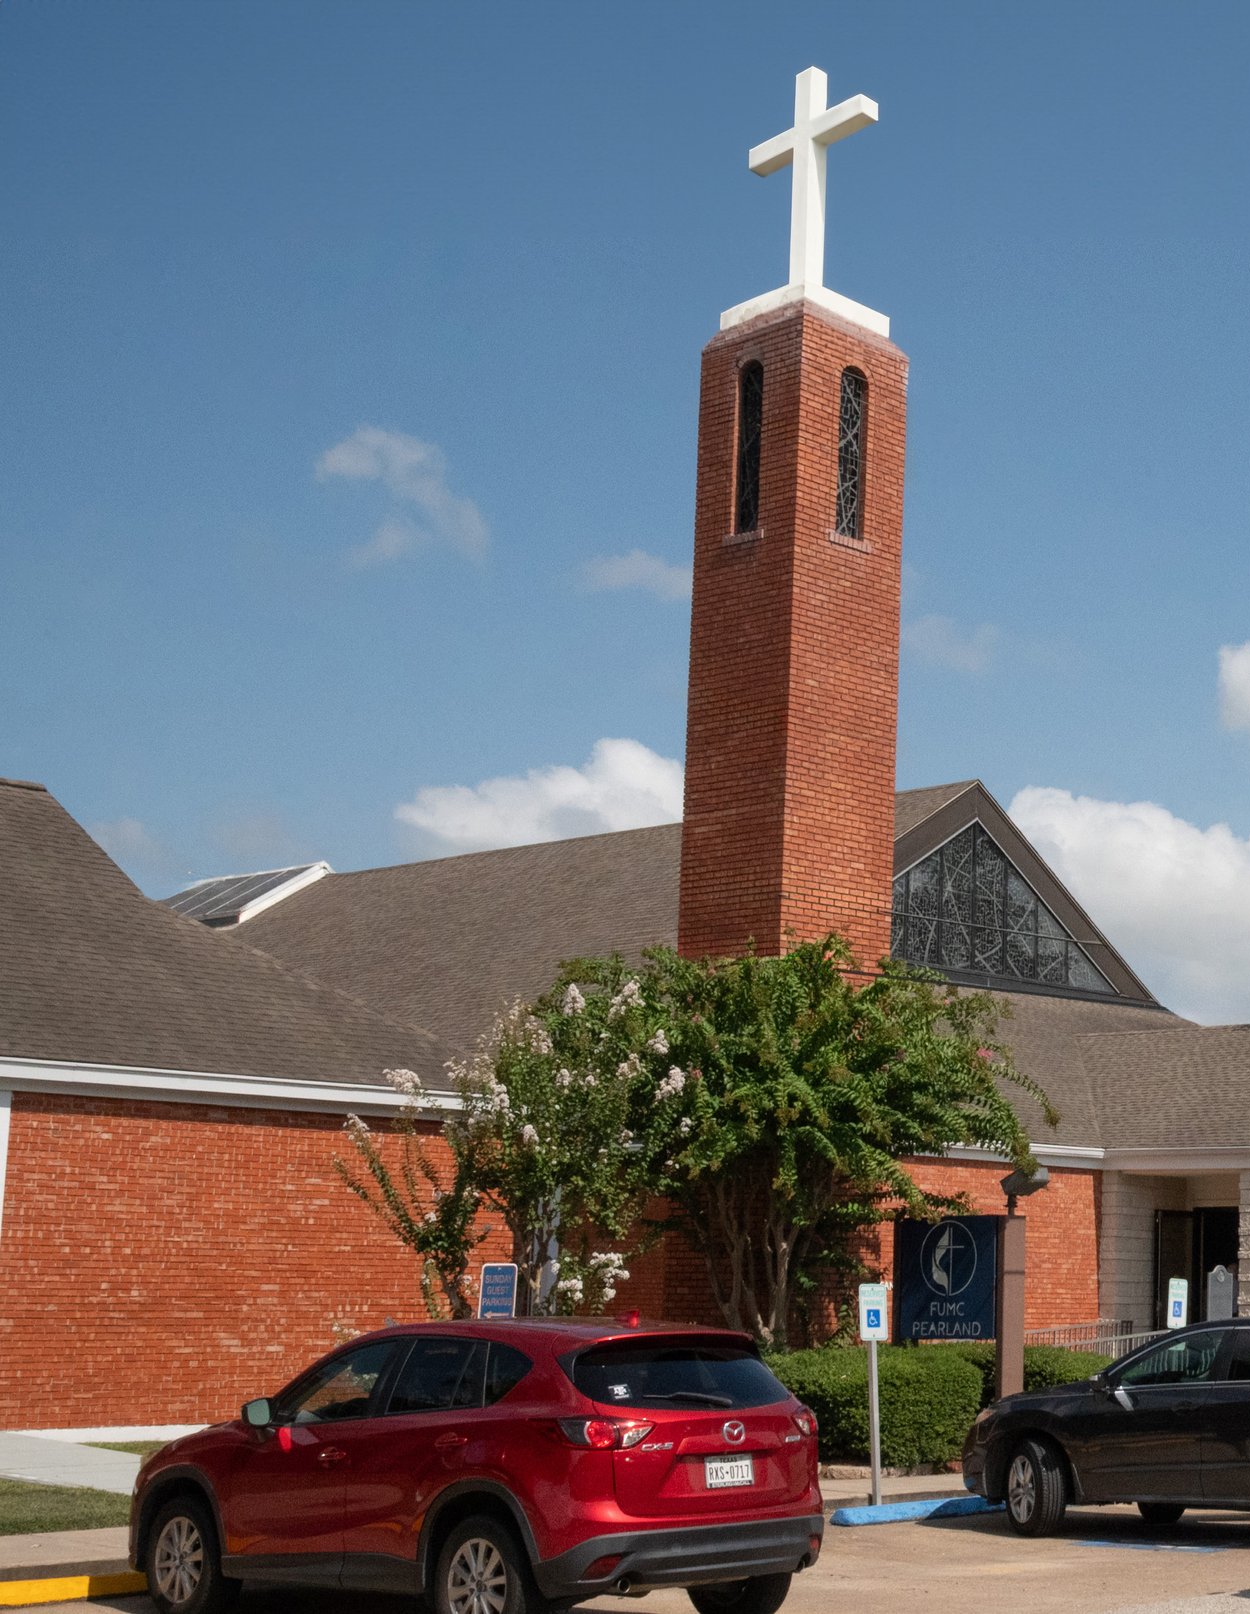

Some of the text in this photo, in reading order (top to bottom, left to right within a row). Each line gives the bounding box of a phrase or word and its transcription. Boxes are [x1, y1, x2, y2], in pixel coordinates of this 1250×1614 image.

[484, 1274, 513, 1285] SUNDAY
[486, 1286, 510, 1296] GUEST
[482, 1297, 513, 1306] PARKING
[930, 1302, 965, 1316] FUMC
[912, 1321, 982, 1336] PEARLAND
[641, 1442, 674, 1452] CX-5
